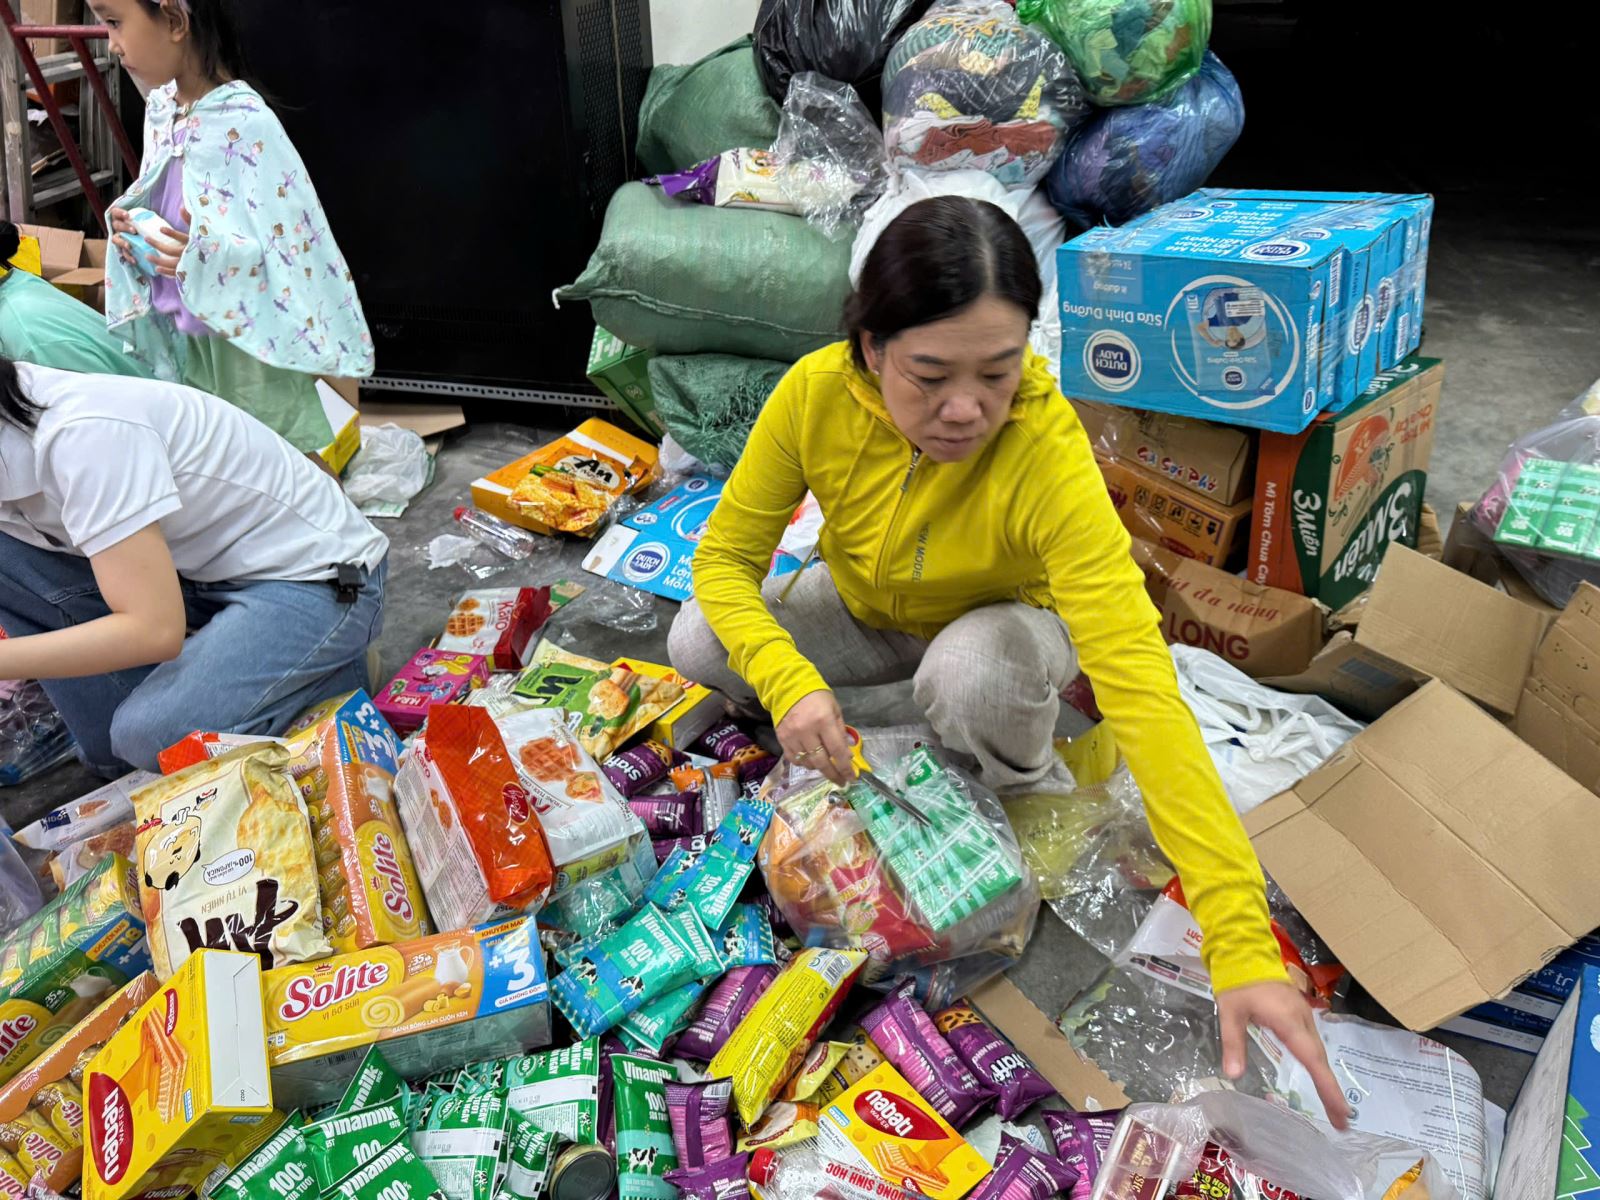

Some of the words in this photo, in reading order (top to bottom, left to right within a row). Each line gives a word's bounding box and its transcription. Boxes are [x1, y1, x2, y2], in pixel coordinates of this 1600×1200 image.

[1062, 300, 1102, 320] Dưỡng
[1106, 308, 1134, 324] Dinh
[1137, 312, 1164, 327] Sữa
[1095, 358, 1128, 371] DUTCH
[1100, 350, 1124, 361] LADY
[573, 456, 614, 483] An
[1262, 500, 1276, 529] Tôm
[920, 521, 931, 545] NEW
[1259, 531, 1273, 562] Chua
[634, 560, 655, 571] LADY
[636, 554, 661, 566] DUTCH
[911, 545, 928, 584] MODEL
[670, 564, 692, 581] Lớn
[1256, 566, 1269, 586] Cay
[494, 600, 514, 631] Karo
[1193, 588, 1224, 606] đa
[1228, 602, 1279, 622] năng
[1169, 612, 1250, 660] LONG
[415, 746, 431, 780] Karo
[602, 755, 642, 781] Staff
[232, 854, 254, 869] 100%
[371, 832, 414, 924] Solite
[706, 862, 750, 916] Vinamilk
[200, 894, 224, 914] NHIÊN
[224, 890, 238, 904] TỰ
[238, 887, 248, 898] VỊ
[481, 924, 510, 938] KHUYẾN
[640, 912, 685, 961] Vinamilk
[678, 910, 713, 965] Vinamilk
[280, 958, 390, 1022] Solite
[508, 990, 528, 1003] KHÔNG
[322, 1010, 332, 1022] VỊ
[392, 1024, 408, 1034] BÁNH
[409, 1022, 426, 1031] BÔNG
[426, 1019, 438, 1028] LAN
[320, 1106, 399, 1140] Vinamilk
[864, 1090, 914, 1137] nabati
[868, 1108, 890, 1129] WAFER
[102, 1086, 120, 1181] nabati
[325, 1138, 336, 1148] EST
[224, 1124, 300, 1191] Vinamilk
[338, 1142, 410, 1198] Vinamilk
[848, 1168, 875, 1191] SINH
